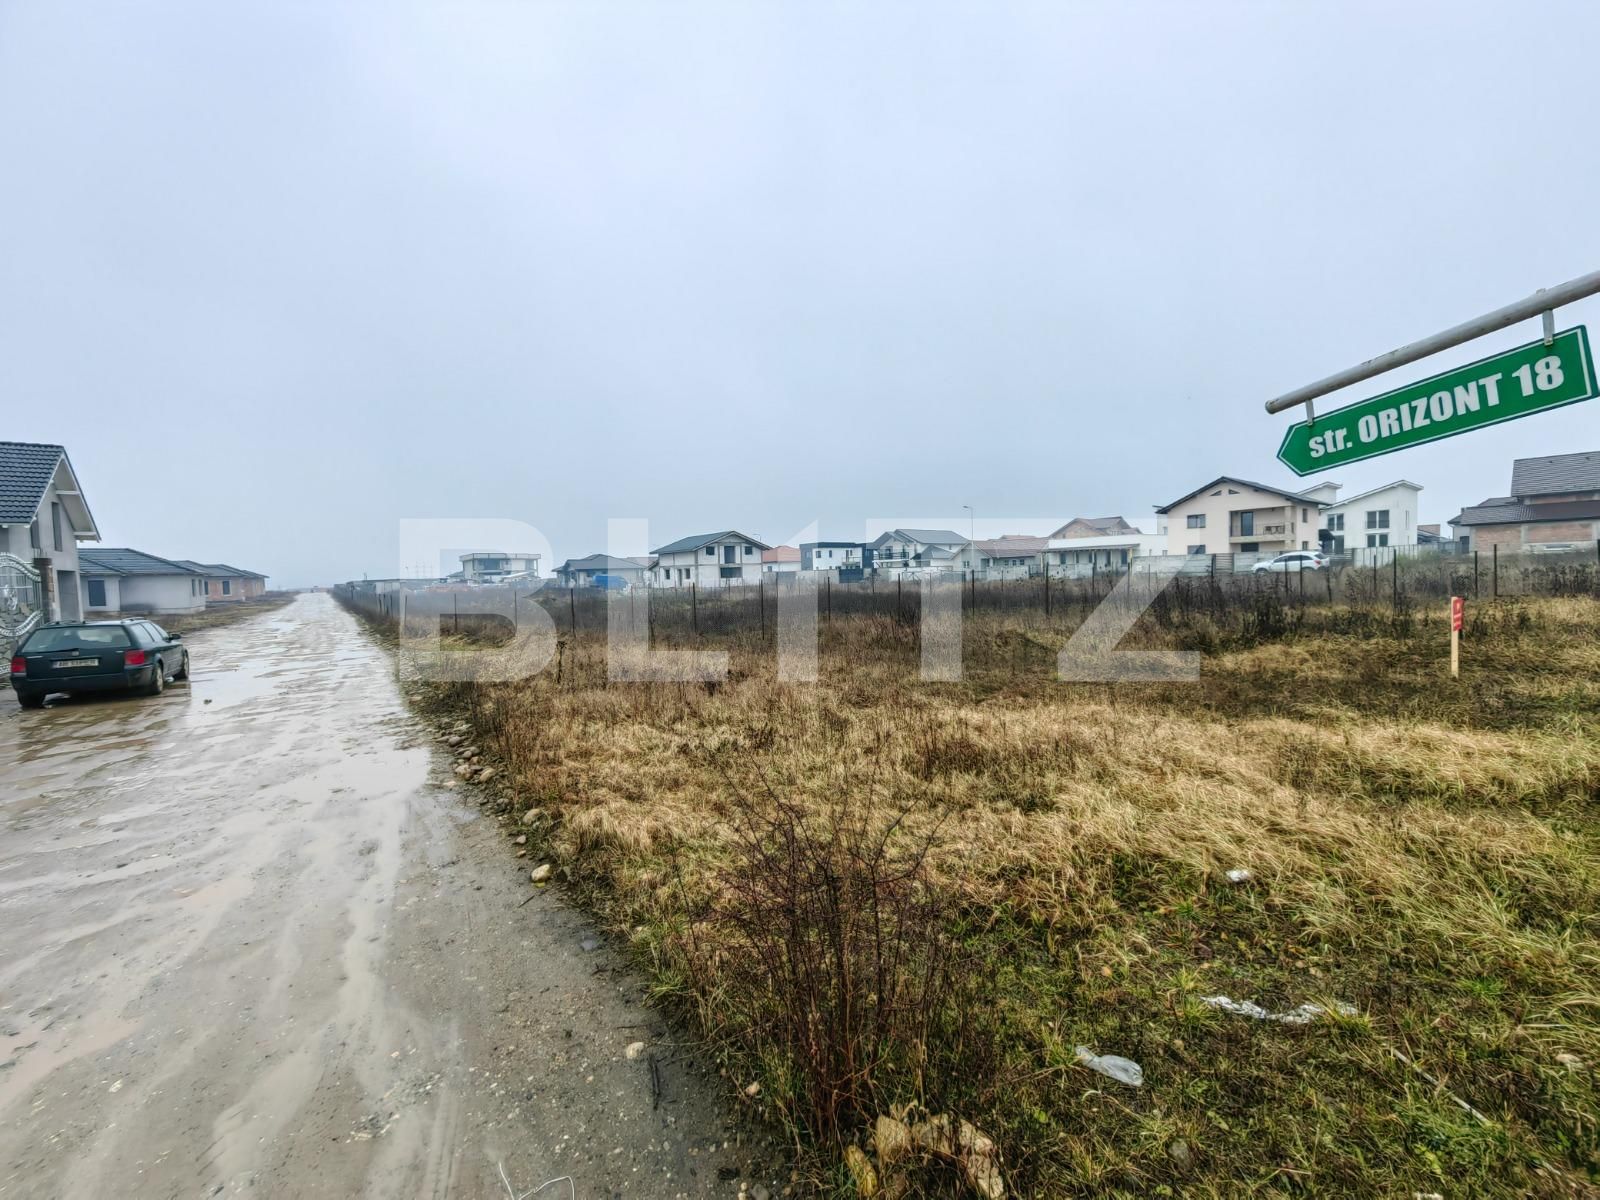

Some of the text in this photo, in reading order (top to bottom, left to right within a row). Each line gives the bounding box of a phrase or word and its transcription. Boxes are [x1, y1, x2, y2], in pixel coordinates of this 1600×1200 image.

[1308, 355, 1565, 458] str. ORIZONT 18
